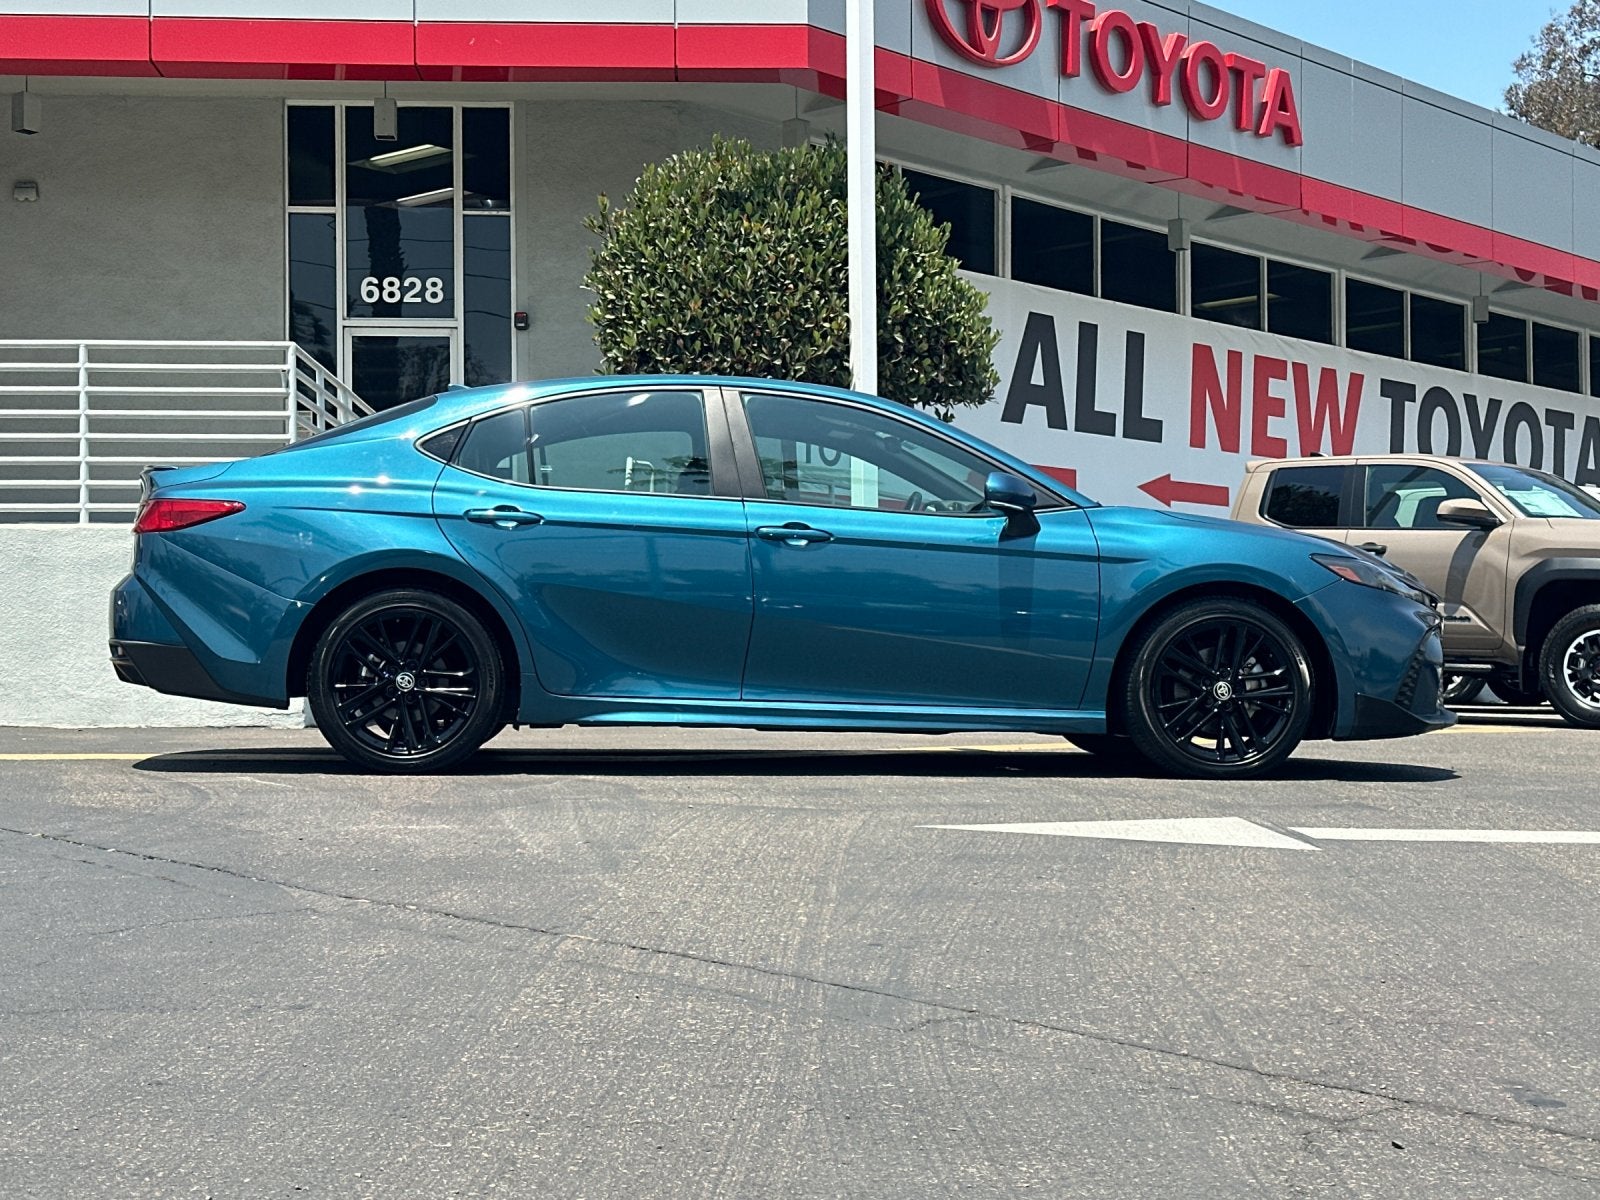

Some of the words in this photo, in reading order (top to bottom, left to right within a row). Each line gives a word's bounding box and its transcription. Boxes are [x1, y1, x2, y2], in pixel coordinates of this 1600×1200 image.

[1046, 0, 1303, 146] TOYOTA
[360, 276, 444, 304] 6828
[1001, 311, 1163, 443] ALL
[1189, 343, 1365, 459] NEW
[1380, 378, 1600, 486] TOYOTA
